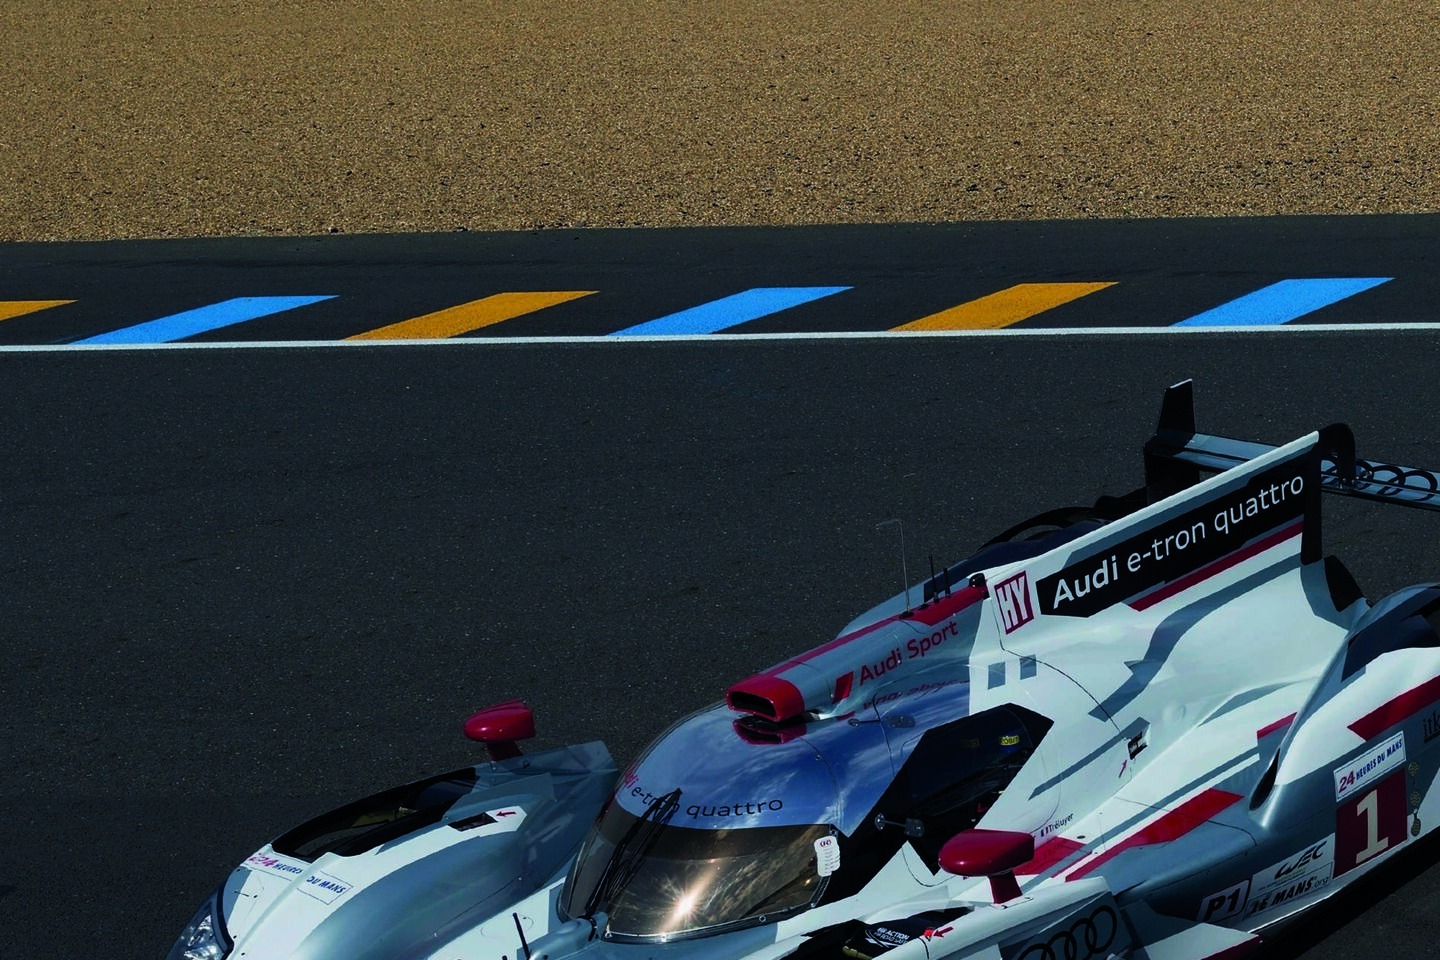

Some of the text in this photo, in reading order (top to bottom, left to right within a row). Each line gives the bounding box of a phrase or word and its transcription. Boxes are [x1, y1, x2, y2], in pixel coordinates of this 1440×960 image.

[1053, 475, 1304, 609] Audi e-tron quattro
[997, 574, 1030, 631] HY
[859, 621, 958, 686] Audi Sport
[1338, 738, 1403, 794] 24 HEURES DU MANS
[631, 786, 783, 820] e-trn quattro
[1355, 789, 1389, 864] 1
[319, 880, 346, 894] MANS
[1203, 887, 1242, 922] P1
